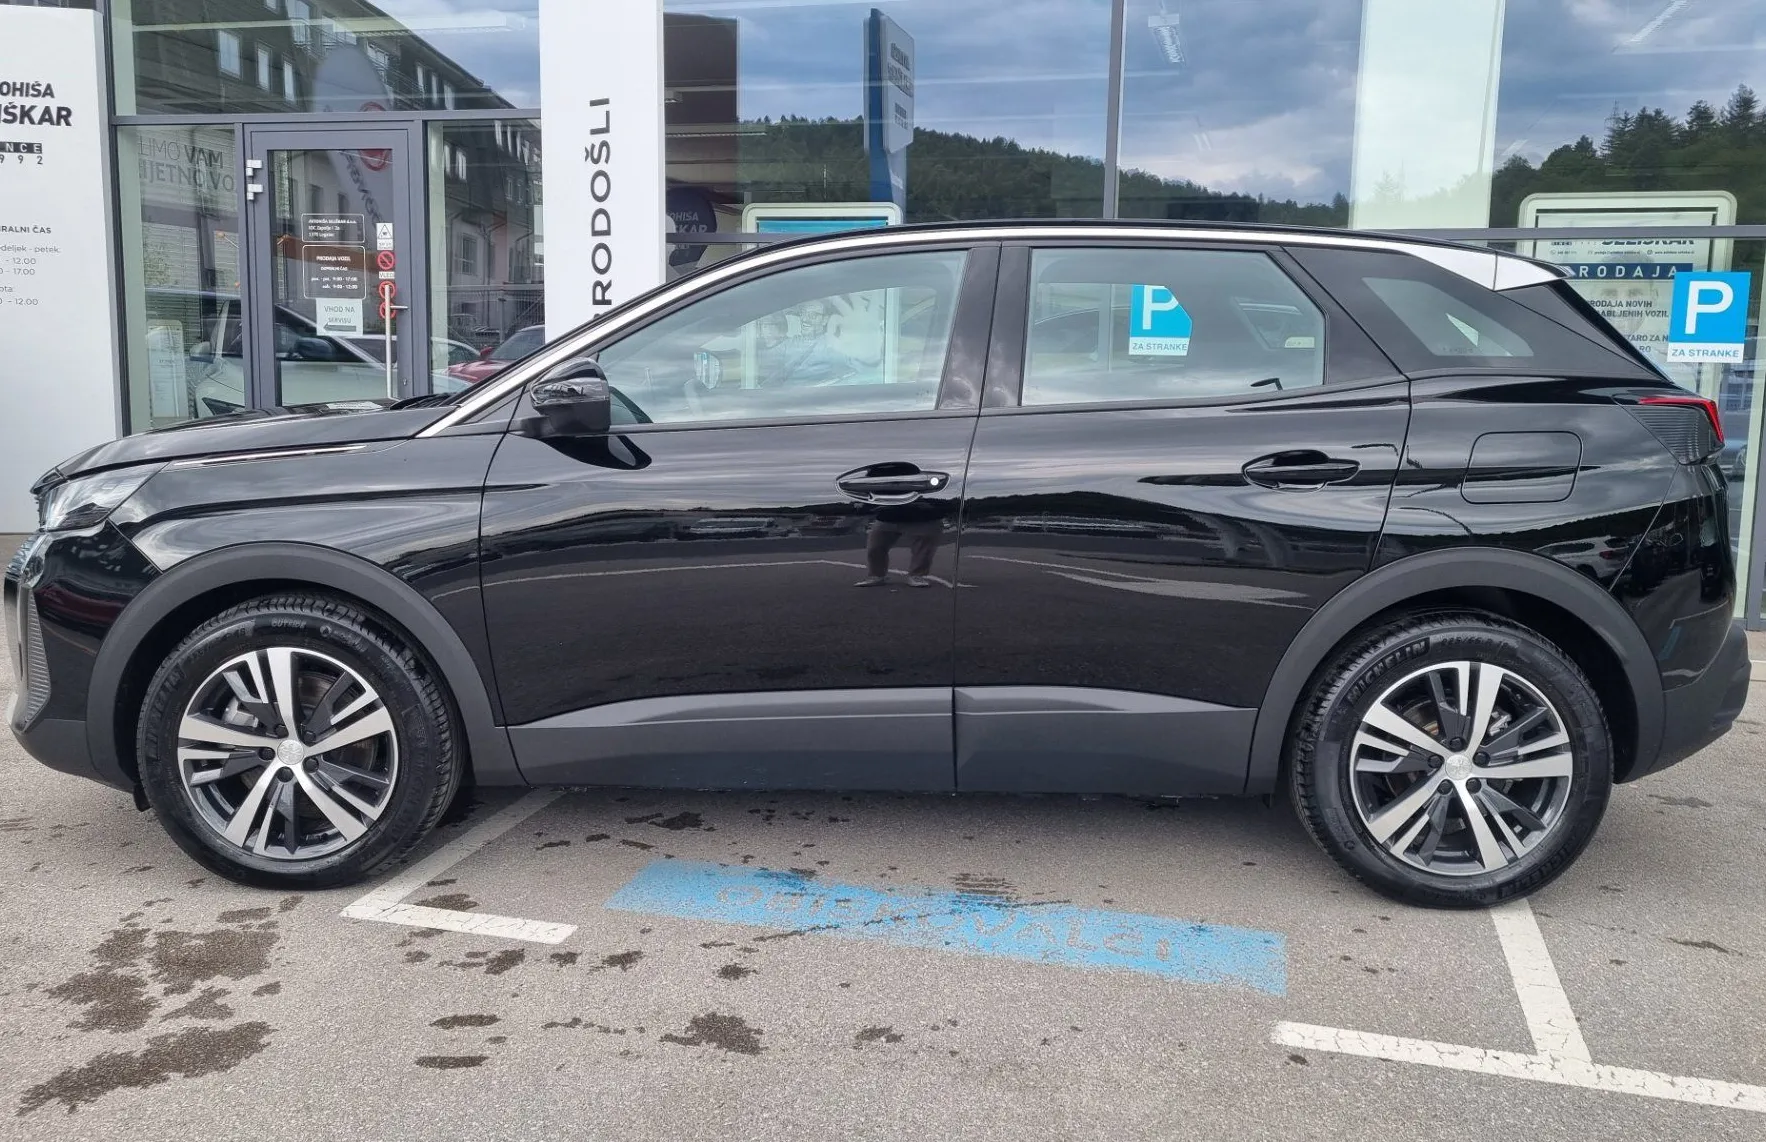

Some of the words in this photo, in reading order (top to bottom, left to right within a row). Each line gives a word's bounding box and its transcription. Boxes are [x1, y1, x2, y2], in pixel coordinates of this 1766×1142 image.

[184, 145, 223, 169] VAM
[585, 98, 612, 322] RODOŠLI
[0, 225, 29, 233] RALNI
[33, 225, 51, 234] ČAS
[0, 245, 26, 253] deljek
[324, 305, 343, 313] VHOD
[1684, 280, 1734, 335] P
[1132, 342, 1144, 351] ZA
[1146, 343, 1187, 351] STRANKE
[1671, 348, 1685, 357] ZA
[1688, 349, 1739, 358] STRANKE
